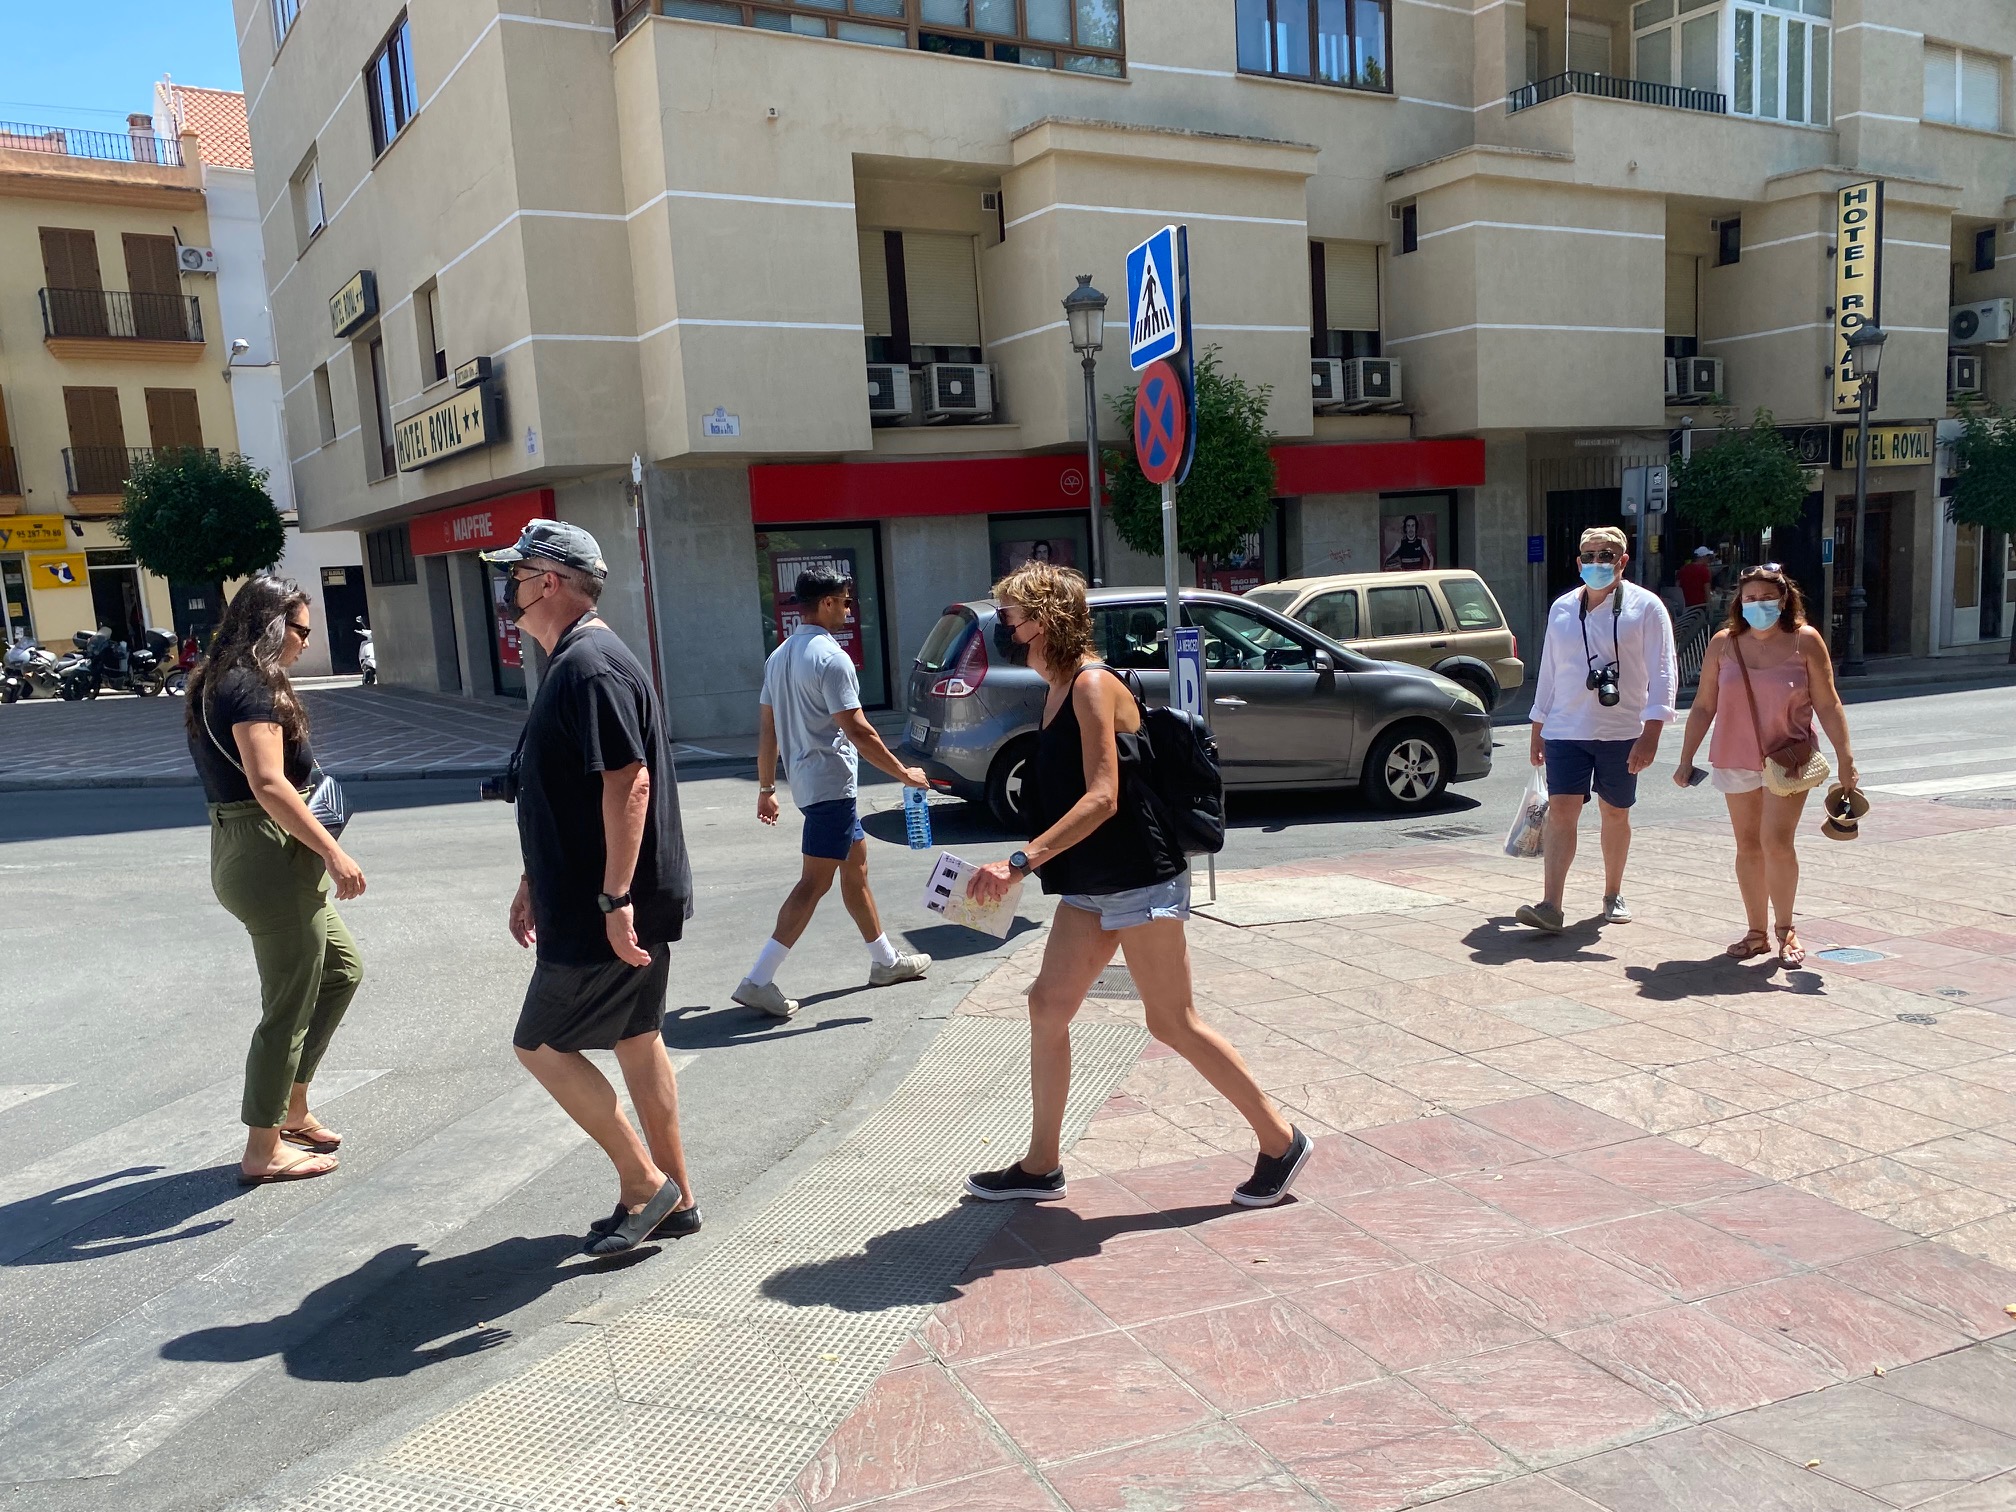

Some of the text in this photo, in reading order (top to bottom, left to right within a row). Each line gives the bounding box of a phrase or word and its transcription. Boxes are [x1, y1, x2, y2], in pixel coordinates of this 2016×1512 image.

[1843, 188, 1868, 279] HOTEL
[397, 404, 461, 464] HOTEL ROYAL
[1892, 432, 1929, 459] ROYAL
[453, 512, 493, 541] MAPFRE
